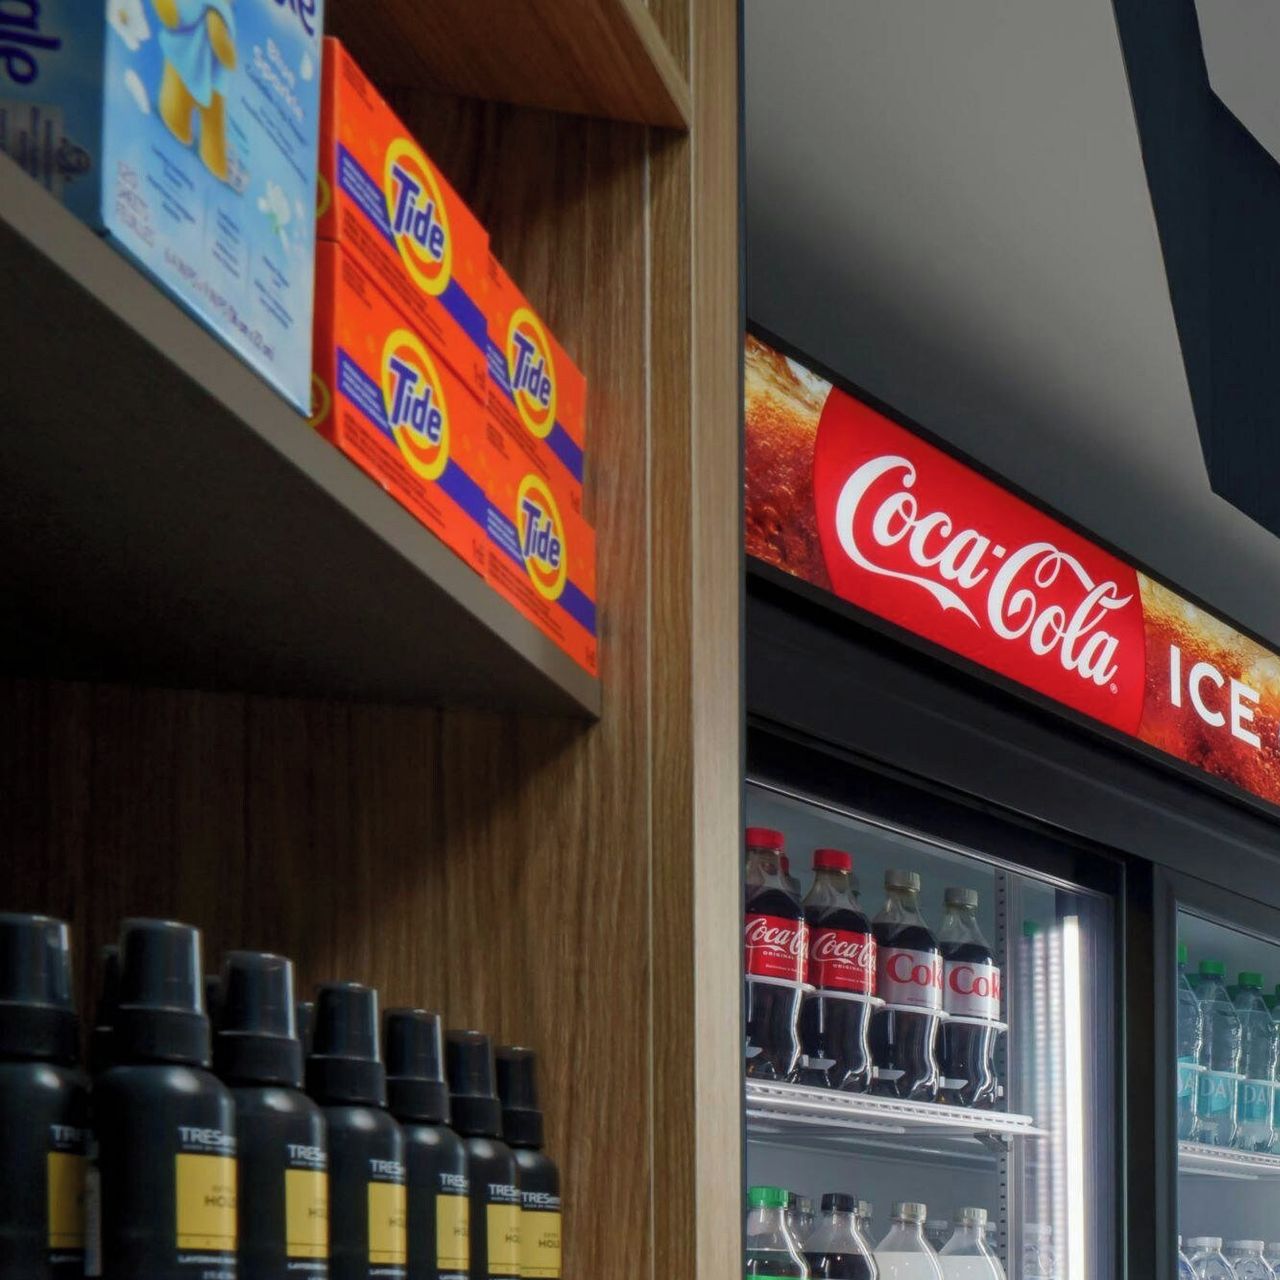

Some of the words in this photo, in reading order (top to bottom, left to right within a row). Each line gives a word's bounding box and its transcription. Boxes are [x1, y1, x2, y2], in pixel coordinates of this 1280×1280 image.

[391, 163, 446, 261] Tide
[389, 357, 443, 444] Tide
[512, 331, 552, 407] Tide
[521, 498, 562, 568] Tide
[834, 454, 1133, 687] Coca-Cola
[1170, 644, 1262, 751] ICE
